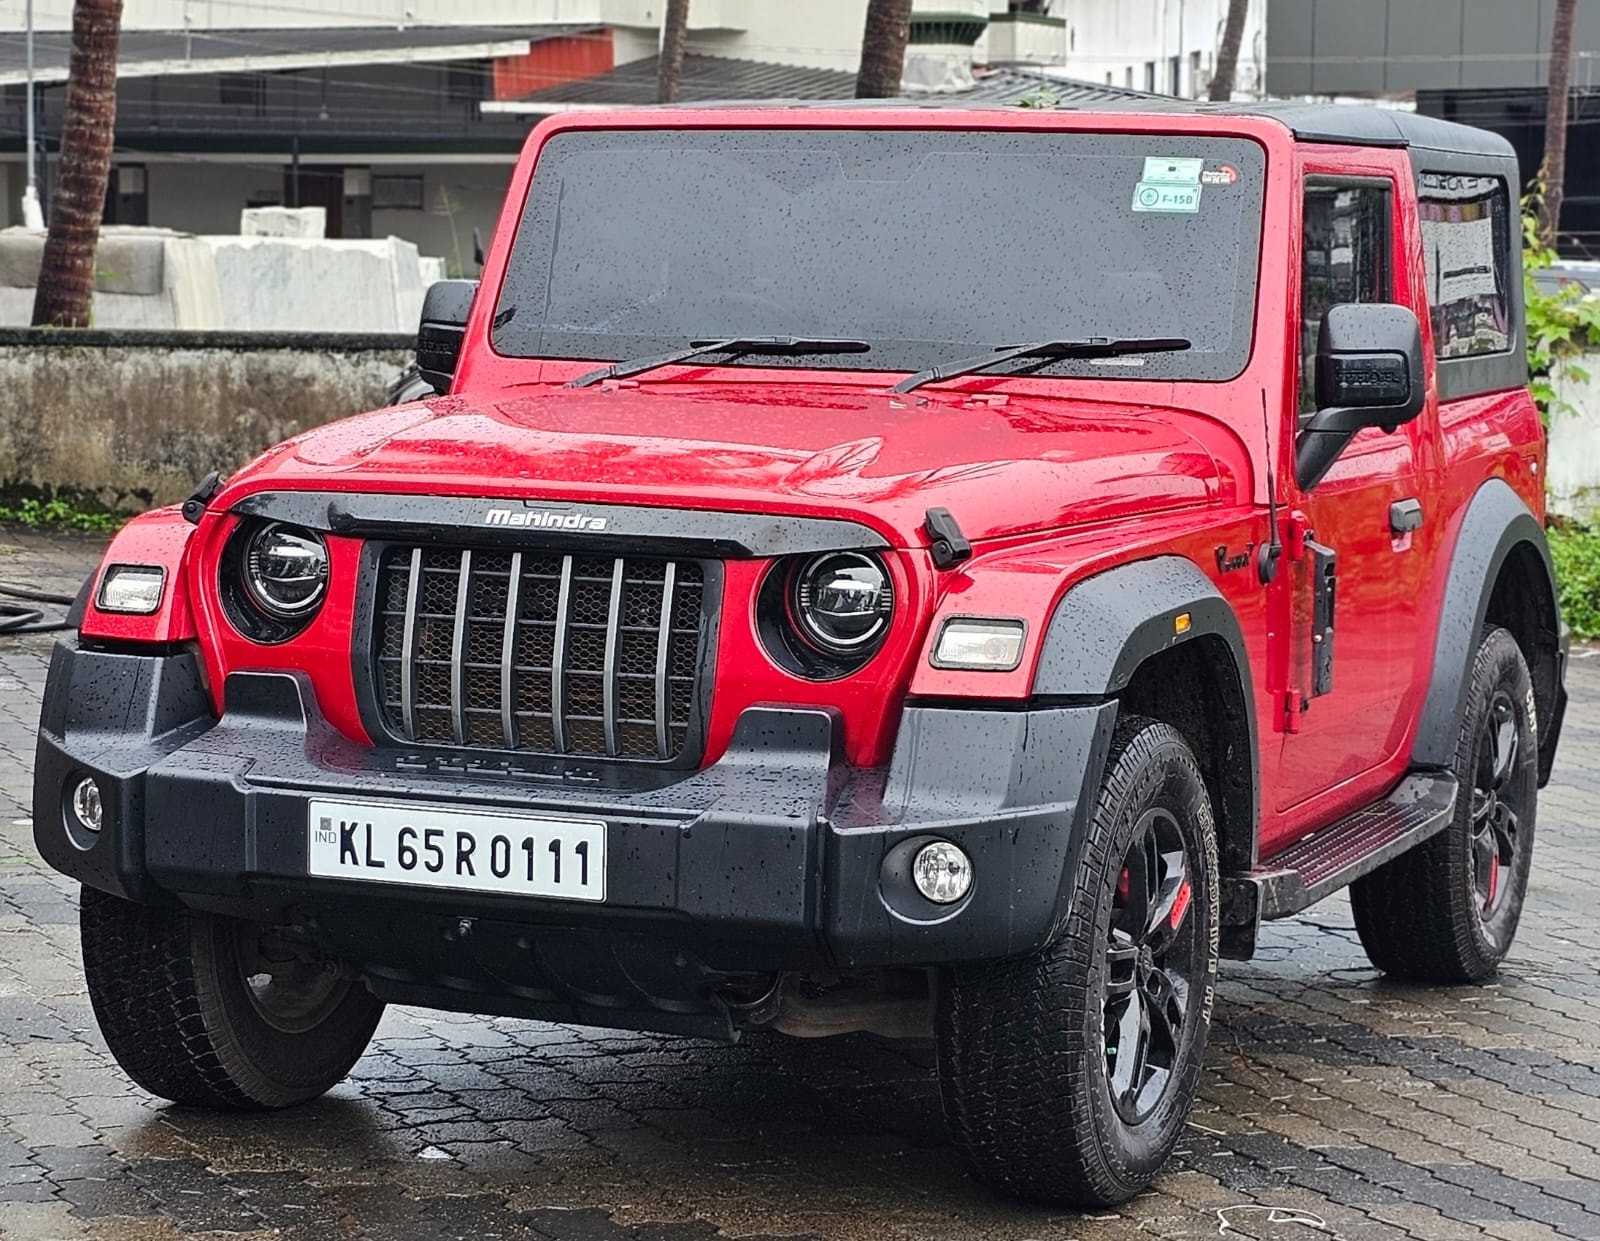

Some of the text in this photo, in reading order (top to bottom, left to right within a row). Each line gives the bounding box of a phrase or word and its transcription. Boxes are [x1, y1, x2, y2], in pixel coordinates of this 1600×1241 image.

[485, 508, 607, 531] Mahindra
[314, 830, 337, 844] IND
[339, 820, 386, 868] KL
[398, 826, 444, 873] 65
[490, 834, 589, 886] 0111
